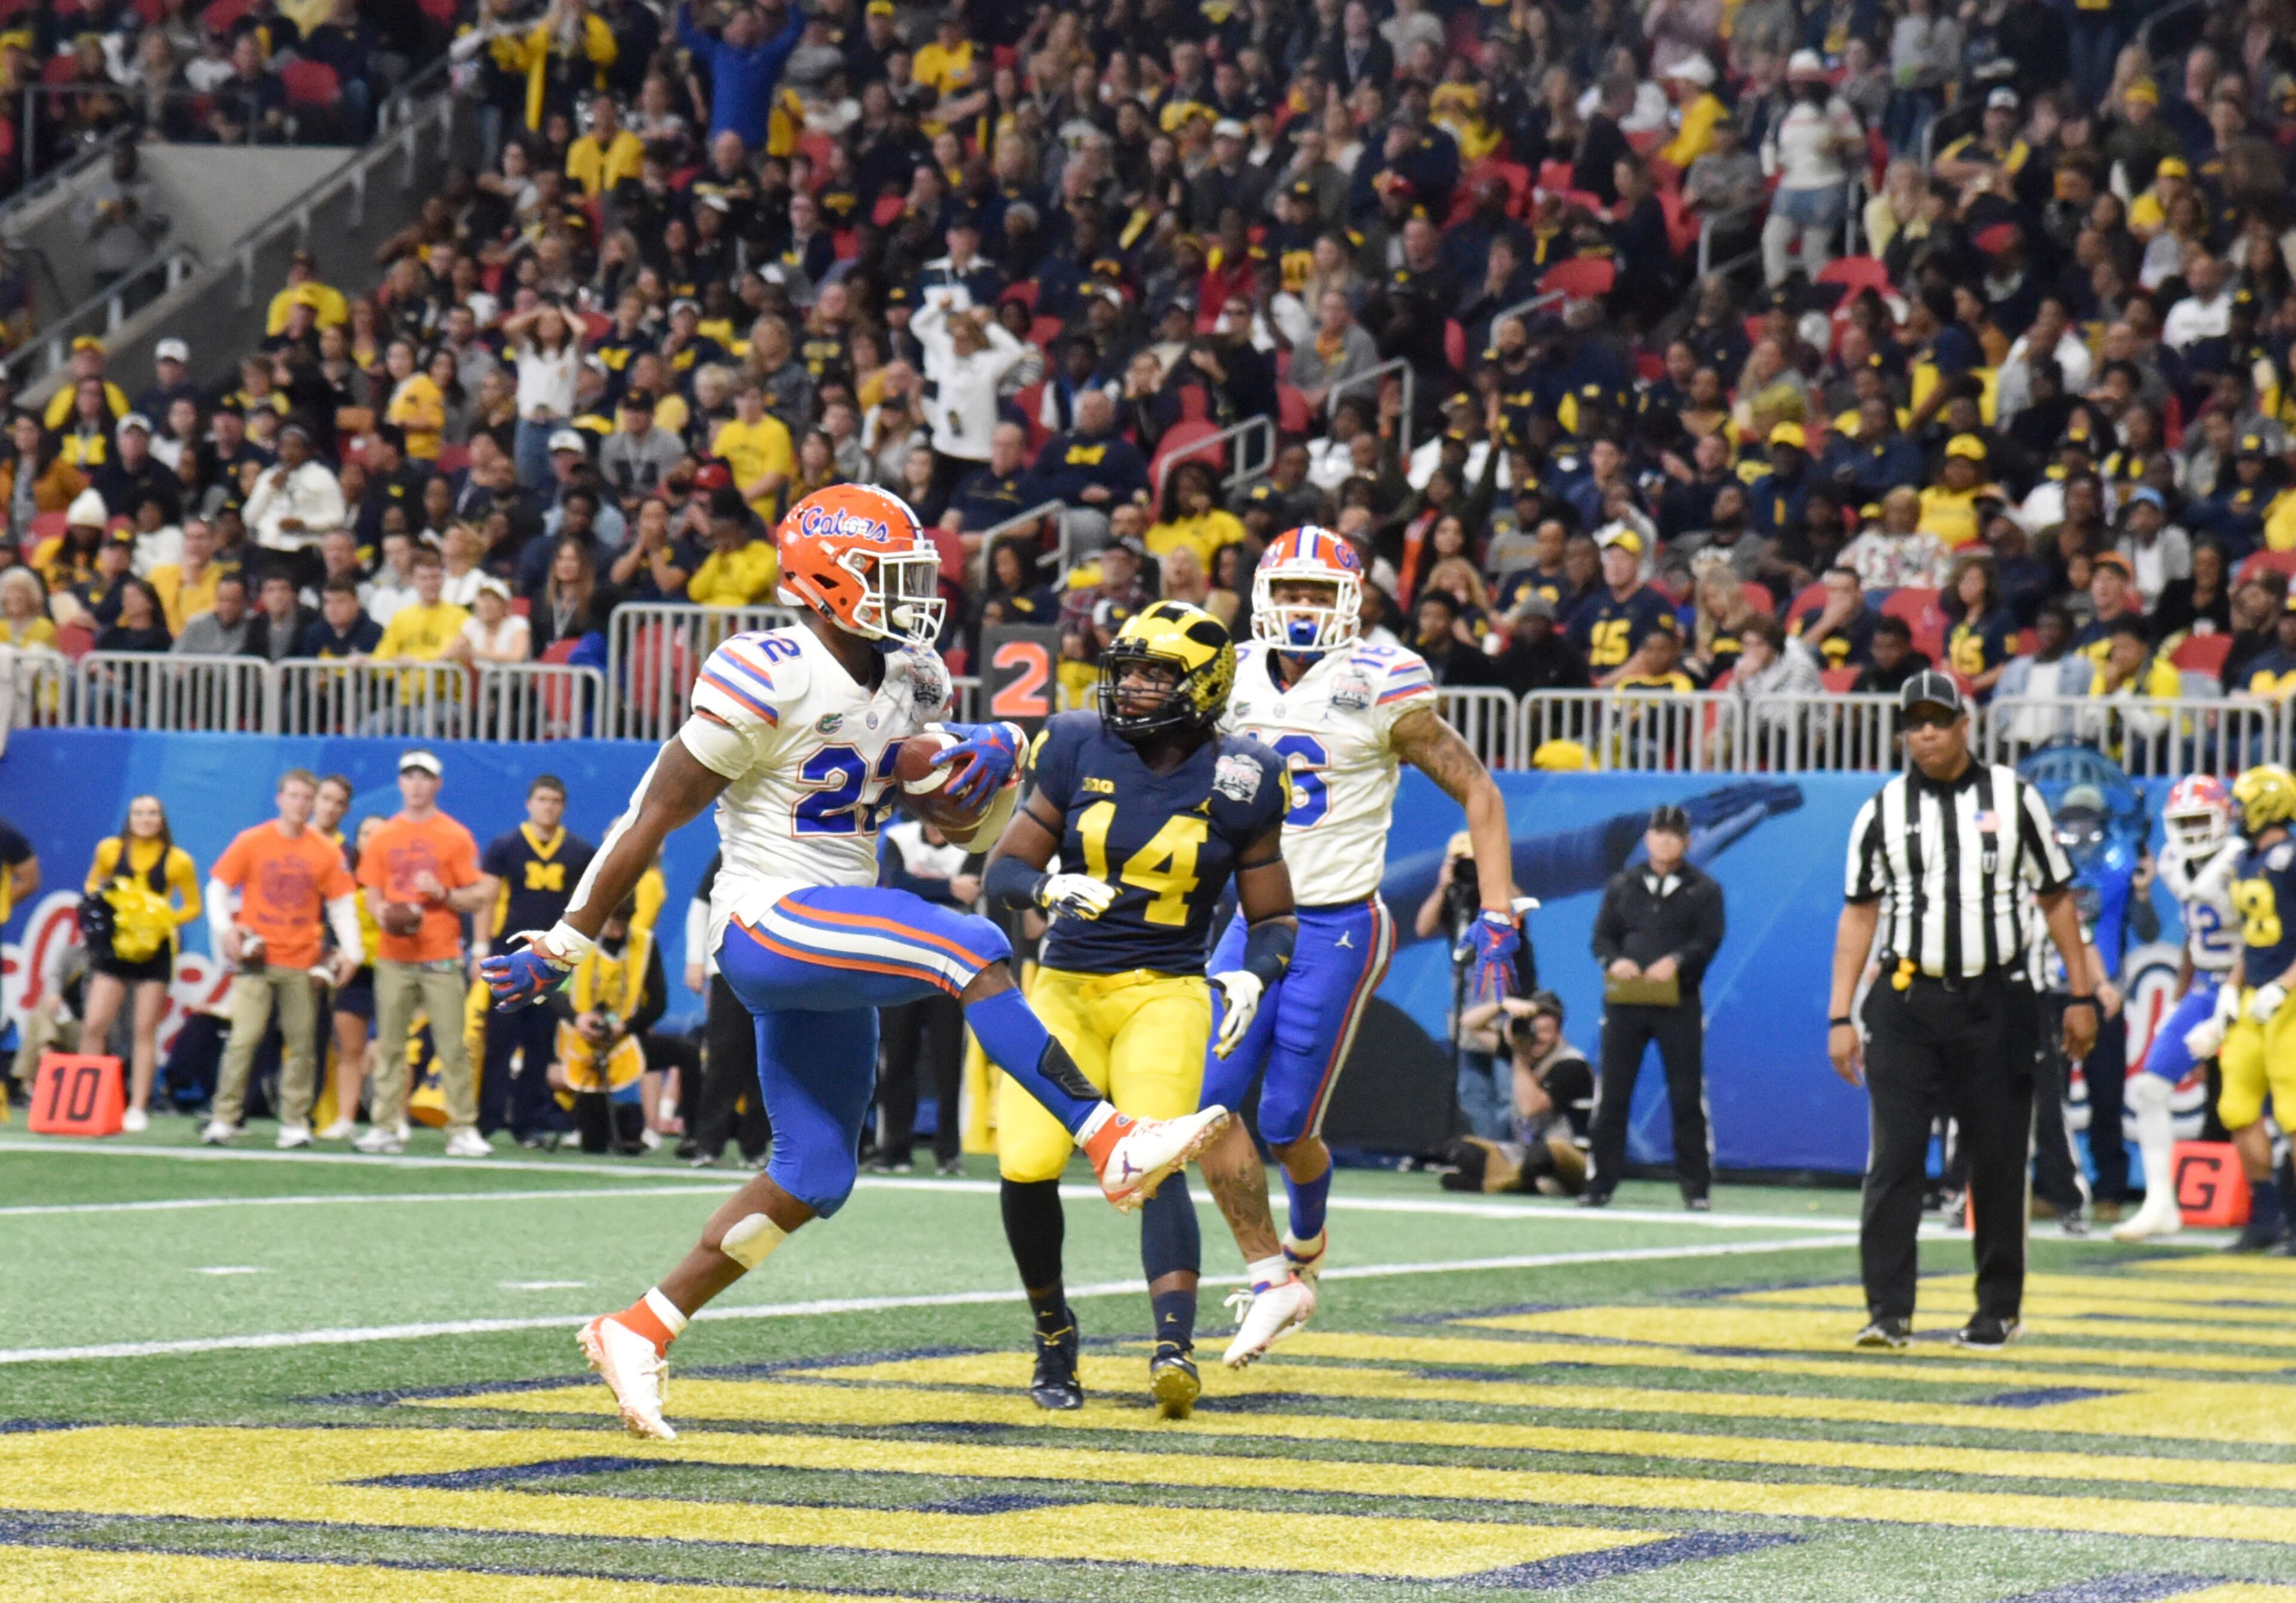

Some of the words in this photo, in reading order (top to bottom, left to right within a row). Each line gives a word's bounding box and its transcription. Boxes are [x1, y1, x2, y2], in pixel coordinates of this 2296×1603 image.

[801, 506, 890, 542] Gators
[991, 641, 1049, 716] 2
[1244, 726, 1332, 832] 6
[524, 861, 566, 892] M
[1076, 800, 1210, 926] 14
[2229, 876, 2282, 948] 8
[48, 1067, 101, 1121] 10
[2174, 1156, 2222, 1211] G
